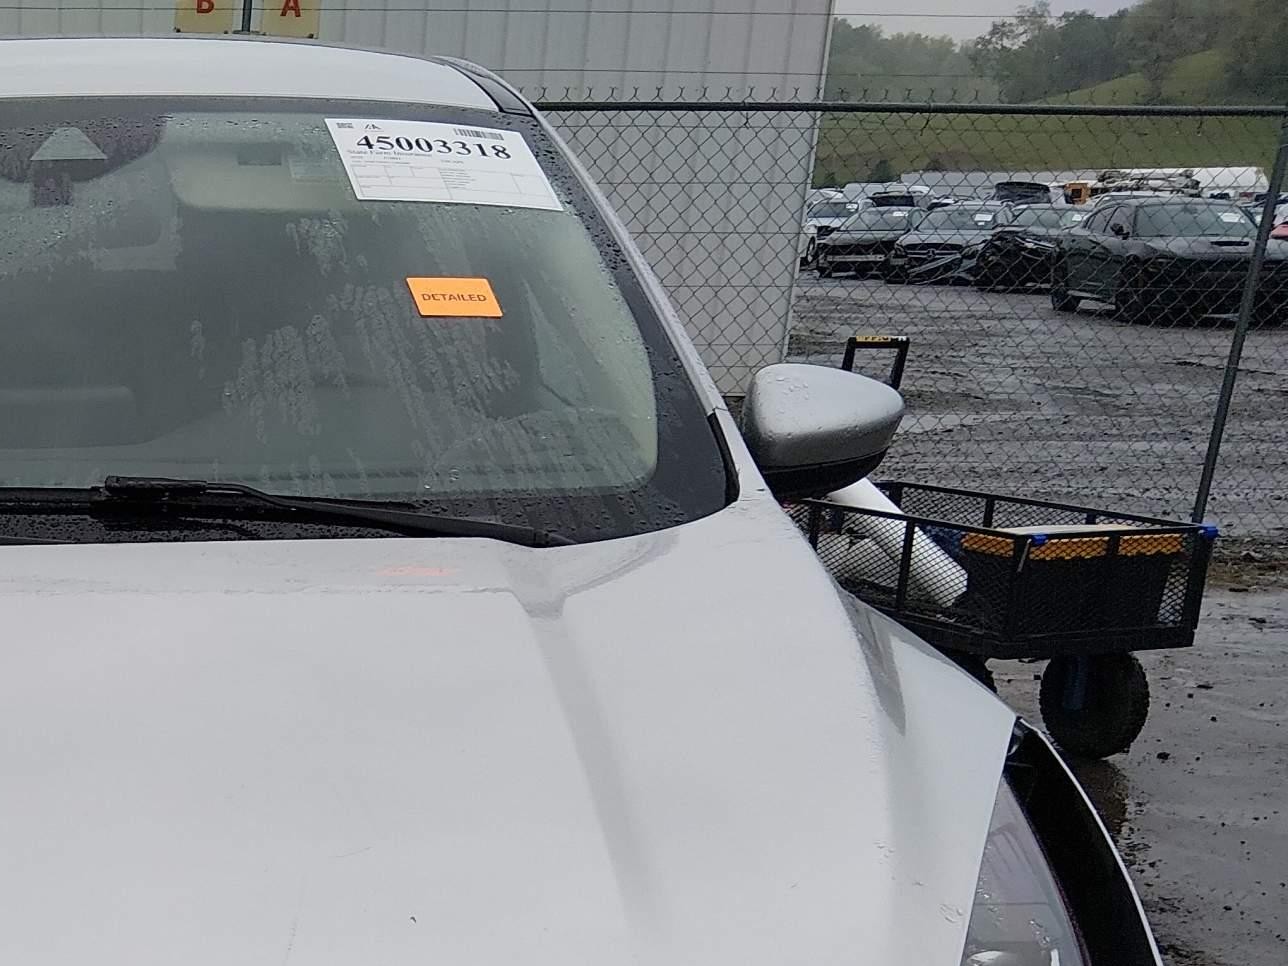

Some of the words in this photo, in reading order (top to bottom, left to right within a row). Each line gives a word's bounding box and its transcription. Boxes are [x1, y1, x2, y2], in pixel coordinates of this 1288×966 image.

[279, 0, 302, 18] A
[356, 135, 512, 160] 45003318
[421, 293, 487, 302] DETAILED
